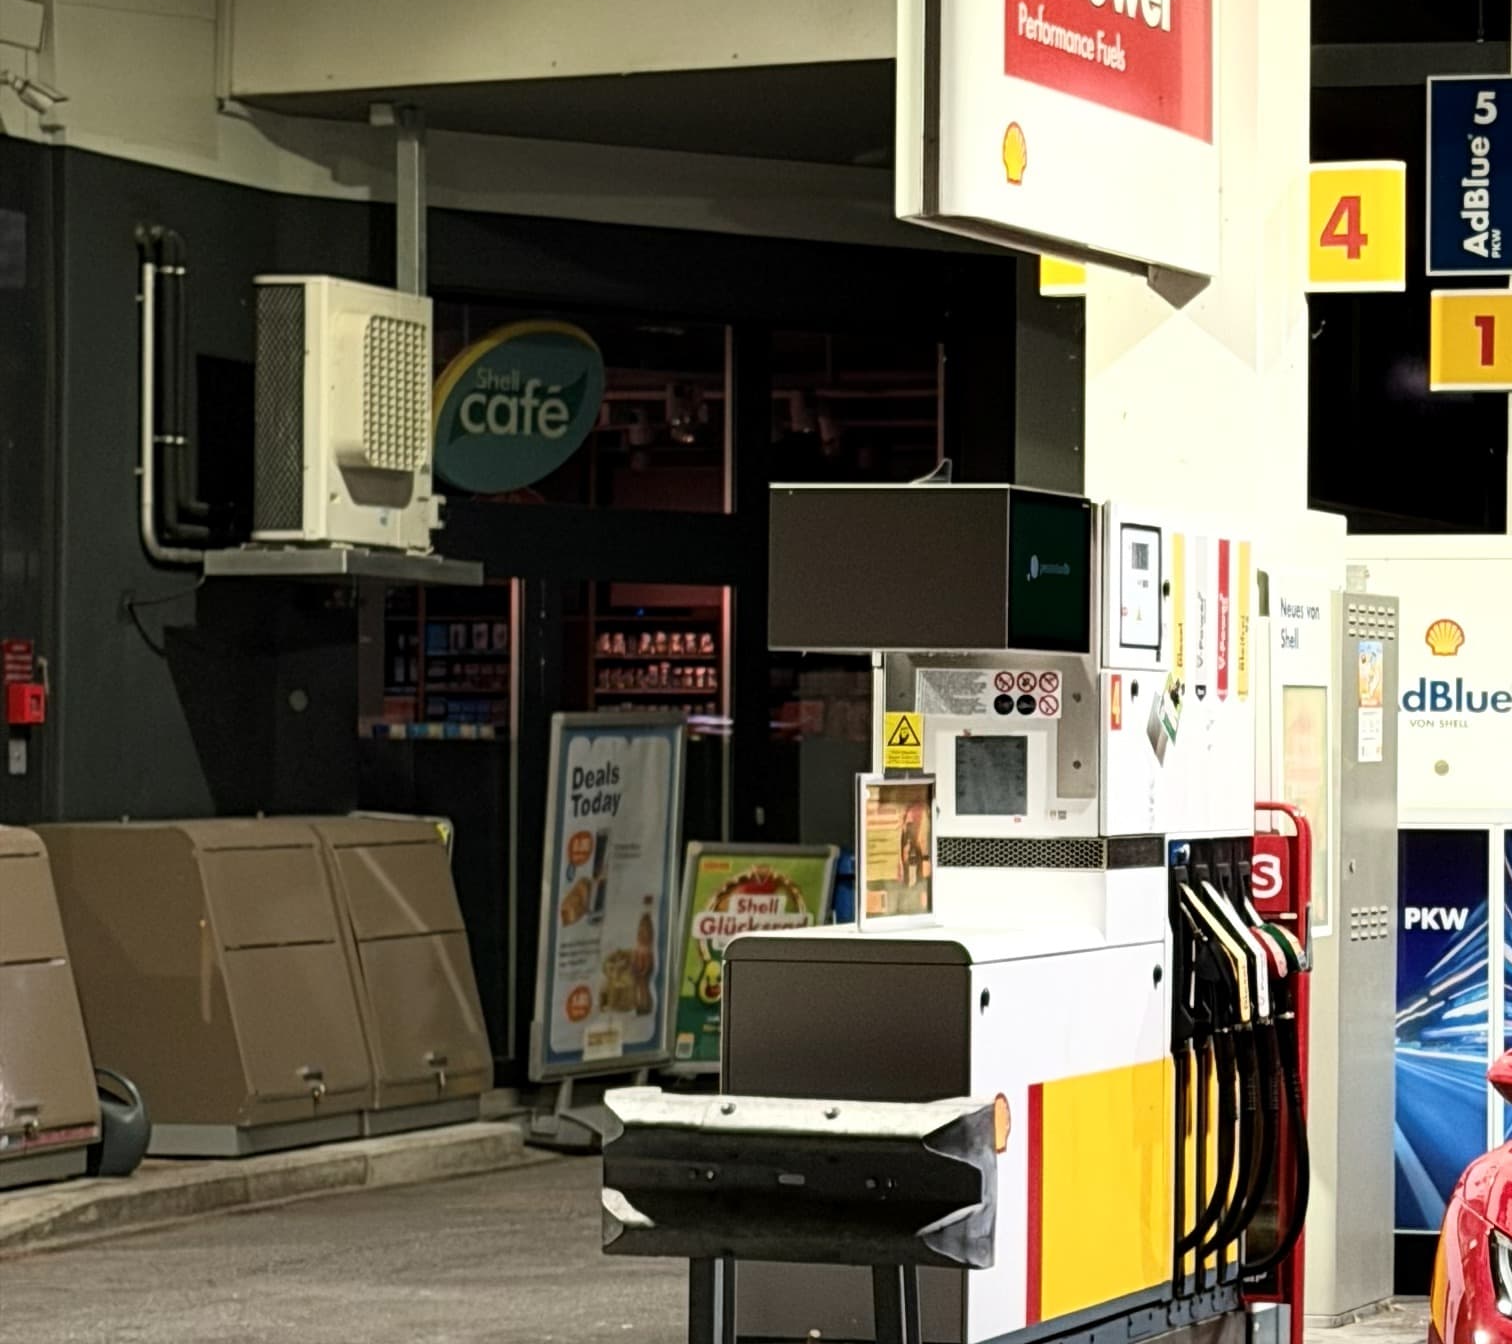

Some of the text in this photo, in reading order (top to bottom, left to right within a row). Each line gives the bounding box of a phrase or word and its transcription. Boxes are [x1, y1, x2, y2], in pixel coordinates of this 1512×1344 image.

[1018, 1, 1126, 72] Performance Fuels
[1474, 91, 1498, 125] 5
[1461, 137, 1491, 258] AdBlue
[1320, 196, 1368, 260] 4
[1491, 228, 1502, 259] PKW
[1474, 315, 1496, 366] 1
[476, 365, 521, 392] Shell
[459, 378, 570, 439] café
[1280, 597, 1320, 620] Neues von
[1280, 627, 1299, 649] Shell
[1409, 719, 1469, 729] VON SHELL
[572, 760, 620, 791] Deals
[571, 791, 622, 819] Today
[737, 896, 779, 914] Shell
[1404, 907, 1469, 931] PKW
